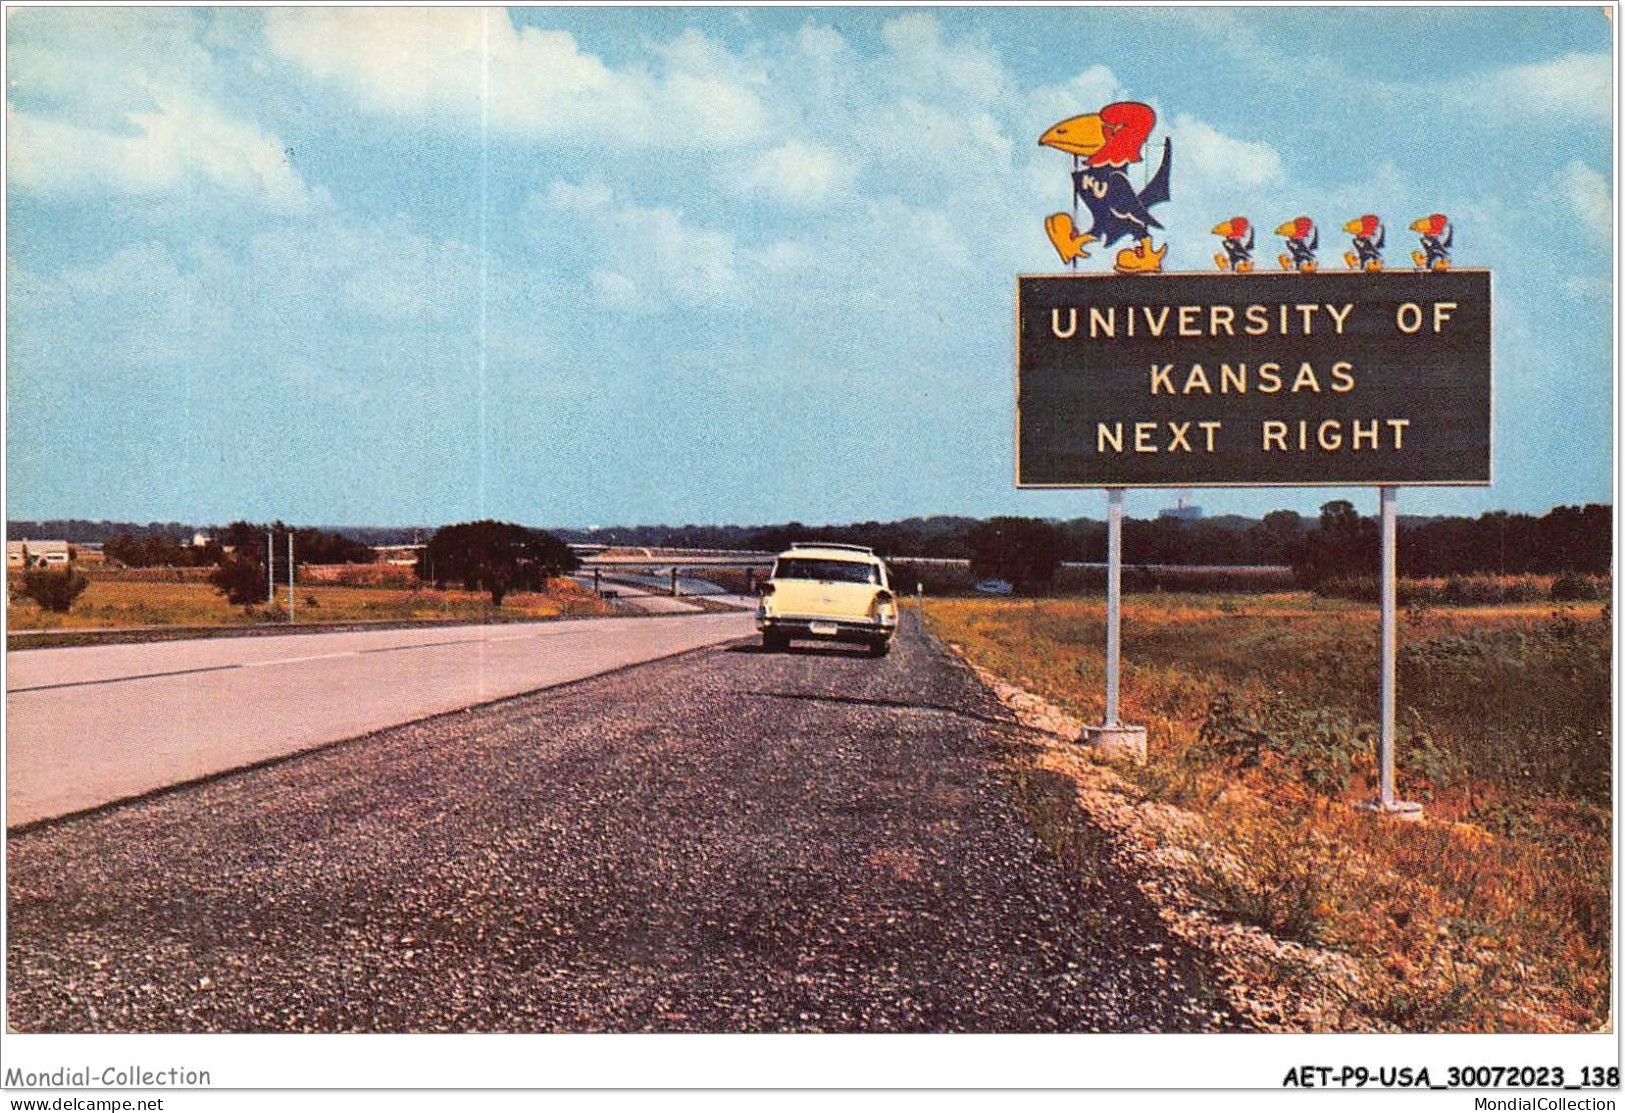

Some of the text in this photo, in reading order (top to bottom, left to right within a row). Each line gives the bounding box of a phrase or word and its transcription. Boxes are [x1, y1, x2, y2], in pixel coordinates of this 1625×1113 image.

[1082, 174, 1108, 199] KU
[1053, 303, 1457, 337] UNIVERSITY OF
[1150, 361, 1356, 395] KANSAS
[1098, 420, 1409, 452] NEXT RIGHT
